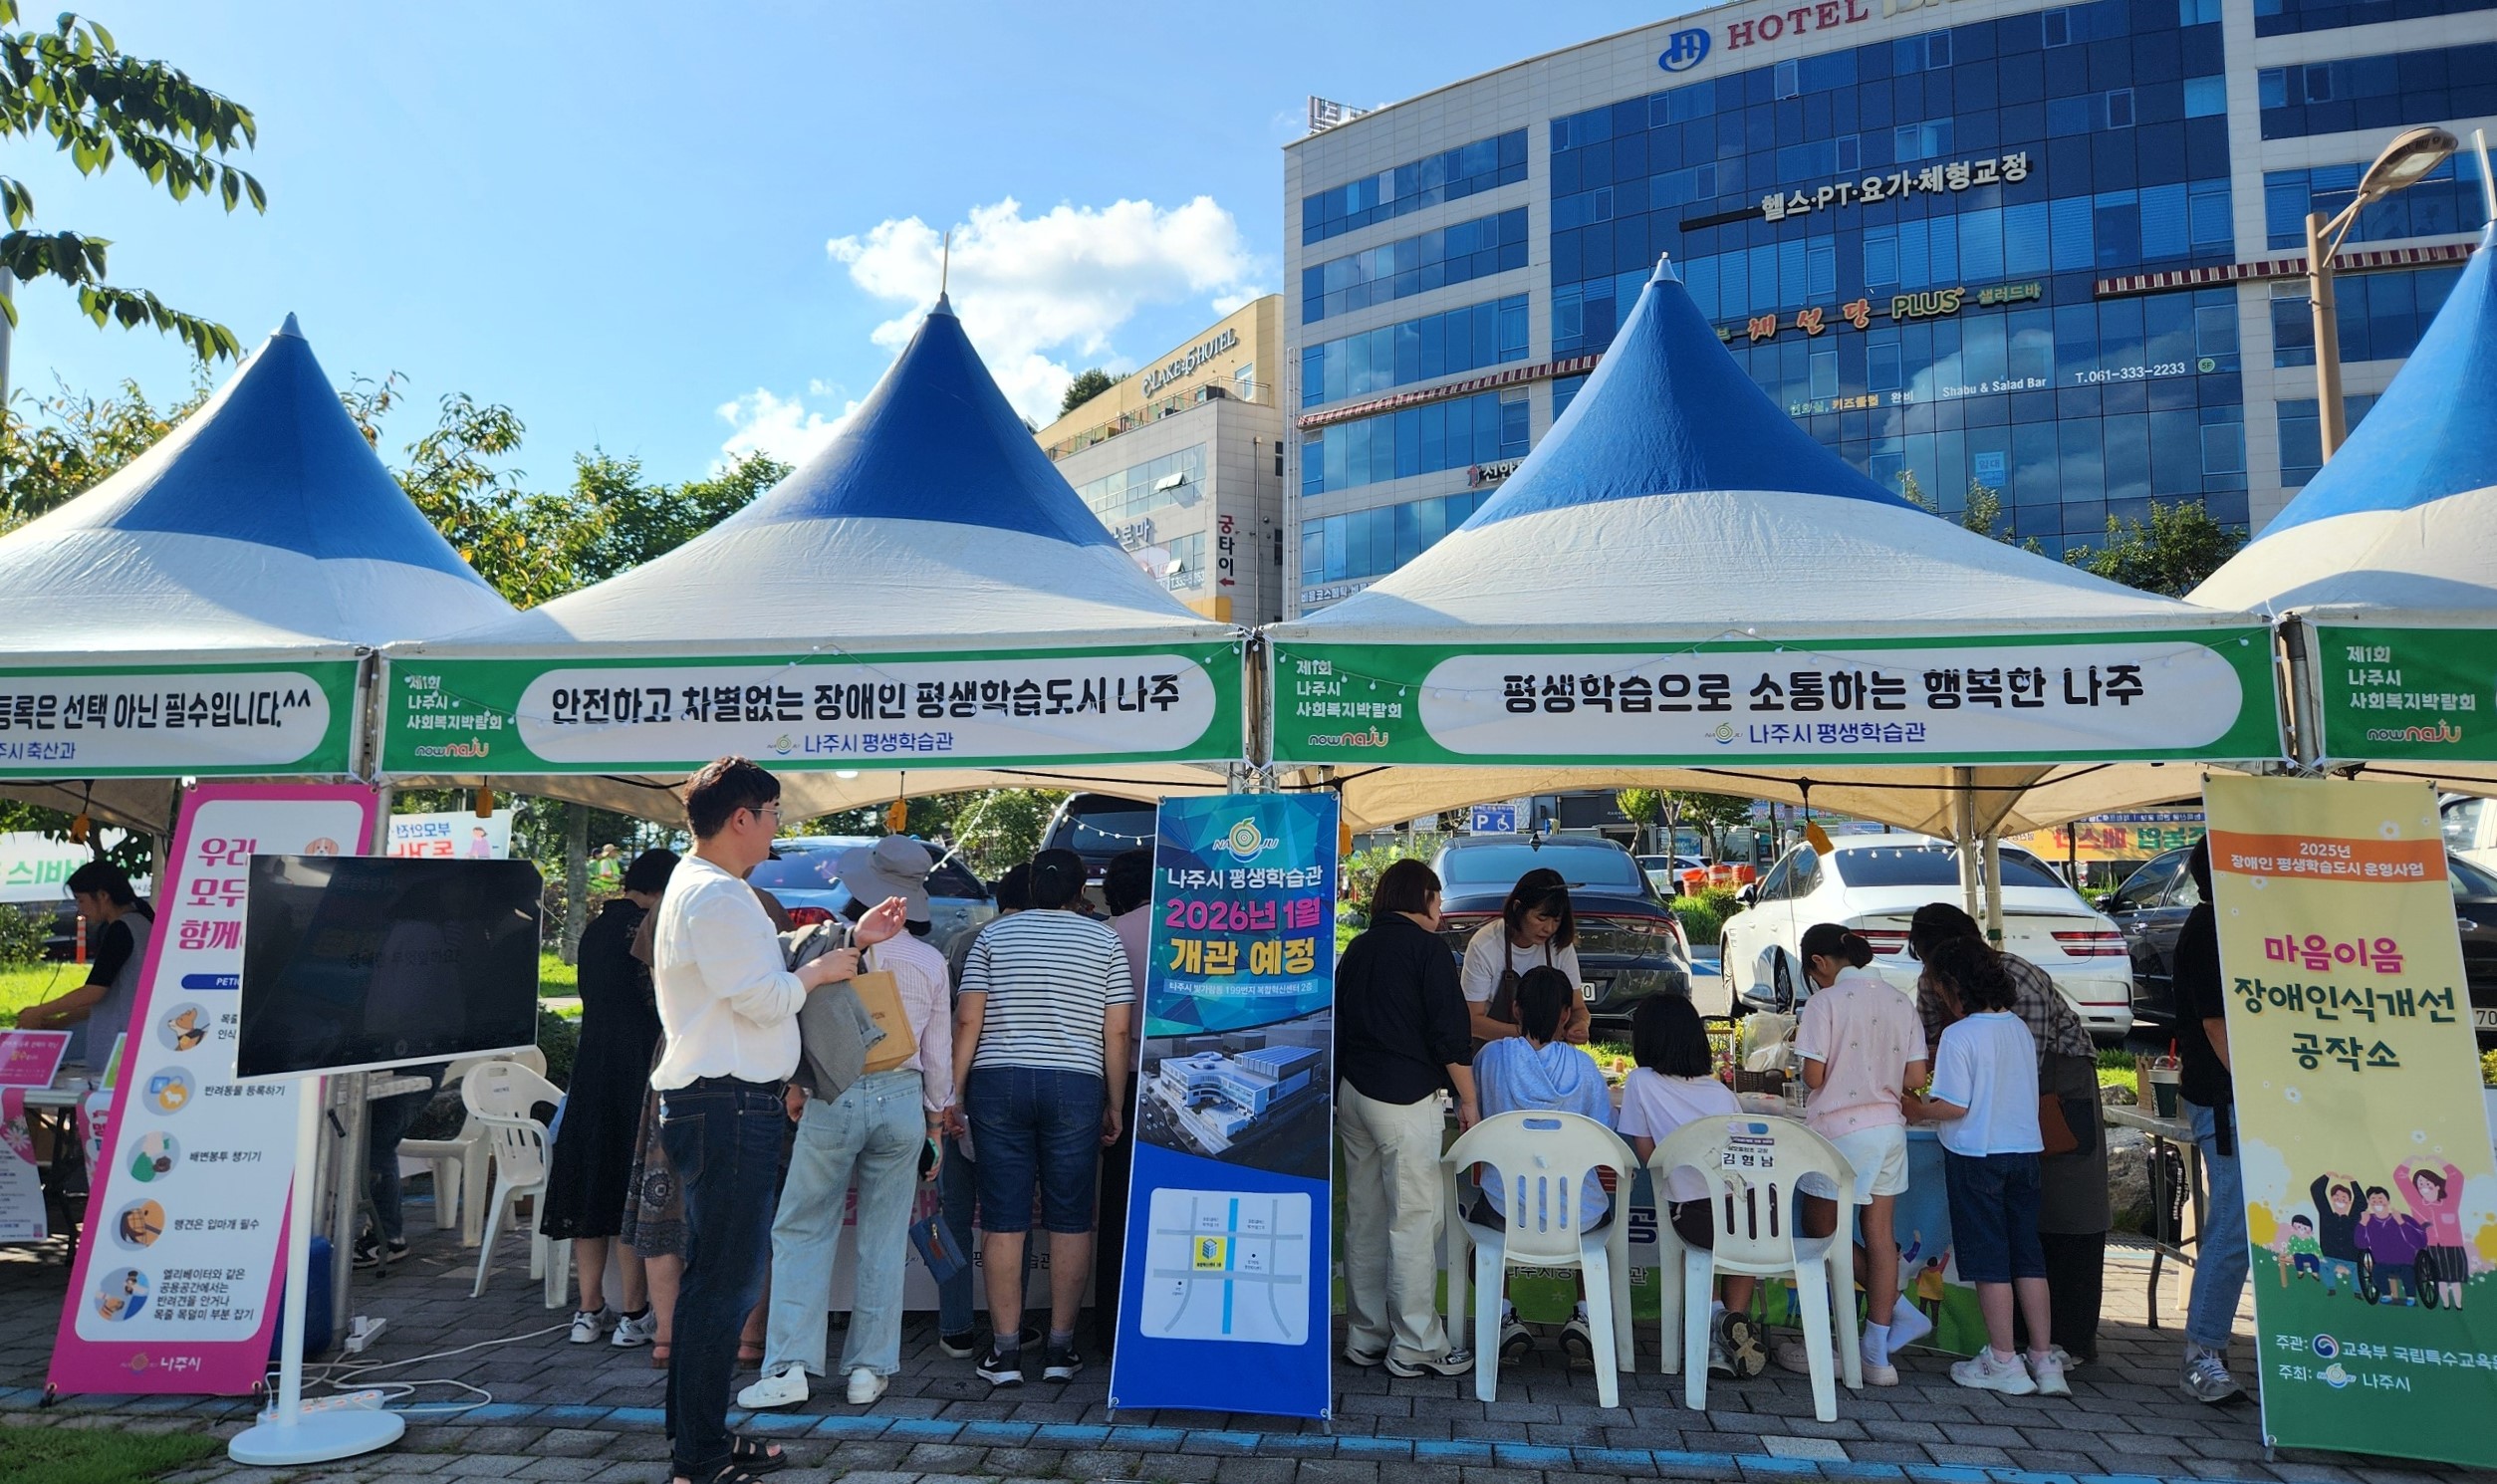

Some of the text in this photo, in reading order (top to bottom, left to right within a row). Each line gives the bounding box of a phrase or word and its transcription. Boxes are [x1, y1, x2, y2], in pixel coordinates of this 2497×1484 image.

[1727, 0, 1869, 50] HOTEL
[1892, 290, 1961, 319] PLUS
[1976, 283, 2041, 305] 샐러드바
[1196, 329, 1236, 365] HOTEL
[1943, 385, 1976, 397] Shabu
[1980, 383, 1988, 392] &
[1992, 378, 2024, 391] Salad
[2027, 376, 2047, 388] Bar
[1218, 514, 1235, 577] 궁타이
[2347, 646, 2390, 663] 제1회
[1296, 659, 1333, 676] 제1회
[2349, 668, 2401, 687] 나주시
[409, 674, 441, 690] 제1회
[1296, 680, 1341, 697] 나주시
[1502, 664, 2144, 714] 평생학습으로 소통하는 행복한 나주
[407, 694, 448, 710] 나주시
[552, 673, 1180, 725] 안전하고 차별없는 장애인 평생학습도시 나주
[1296, 700, 1402, 719] 사회복지박람회
[2350, 692, 2476, 711] 사회복지박람회
[63, 693, 109, 729] 선택
[114, 692, 158, 729] 아닌
[406, 714, 502, 731] 사회복지박람회
[1749, 721, 1926, 745] 나주시 평생학습관
[27, 741, 77, 761] 축산과
[804, 732, 954, 754] 나주시 평생학습관
[1477, 814, 1489, 830] P
[197, 838, 257, 867] 우리
[2299, 842, 2352, 860] 2025년
[2230, 854, 2424, 877] 장애인 평생학습도시 운영사업
[1167, 865, 1324, 889] 나주시 평생학습관
[186, 878, 246, 907] 모두
[1164, 896, 1321, 931] 2026년 1월
[178, 919, 243, 950] 함께
[1168, 937, 1316, 976] 개관 예정
[2264, 933, 2404, 974] 마음이음
[1225, 984, 1256, 995] 199번지
[2233, 977, 2457, 1024] 장애인식개선
[2292, 1032, 2400, 1073] 공작소
[204, 1085, 286, 1098] 반려동물 등록하기
[189, 1150, 263, 1162] 배변봉투 챙기기
[173, 1218, 260, 1231] 맹견은 입마개 필수
[162, 1268, 246, 1281] 엘리베이터와 같은
[159, 1281, 229, 1295] 공용공간에서는
[156, 1294, 230, 1308] 반려견을 안거나
[153, 1307, 255, 1321] 목줄 목덜미 부분 잡기
[2276, 1334, 2309, 1353] 주관:
[2342, 1341, 2388, 1360] 교육부
[160, 1356, 201, 1372] 나주시
[2278, 1363, 2411, 1392] 주최: 나주시
